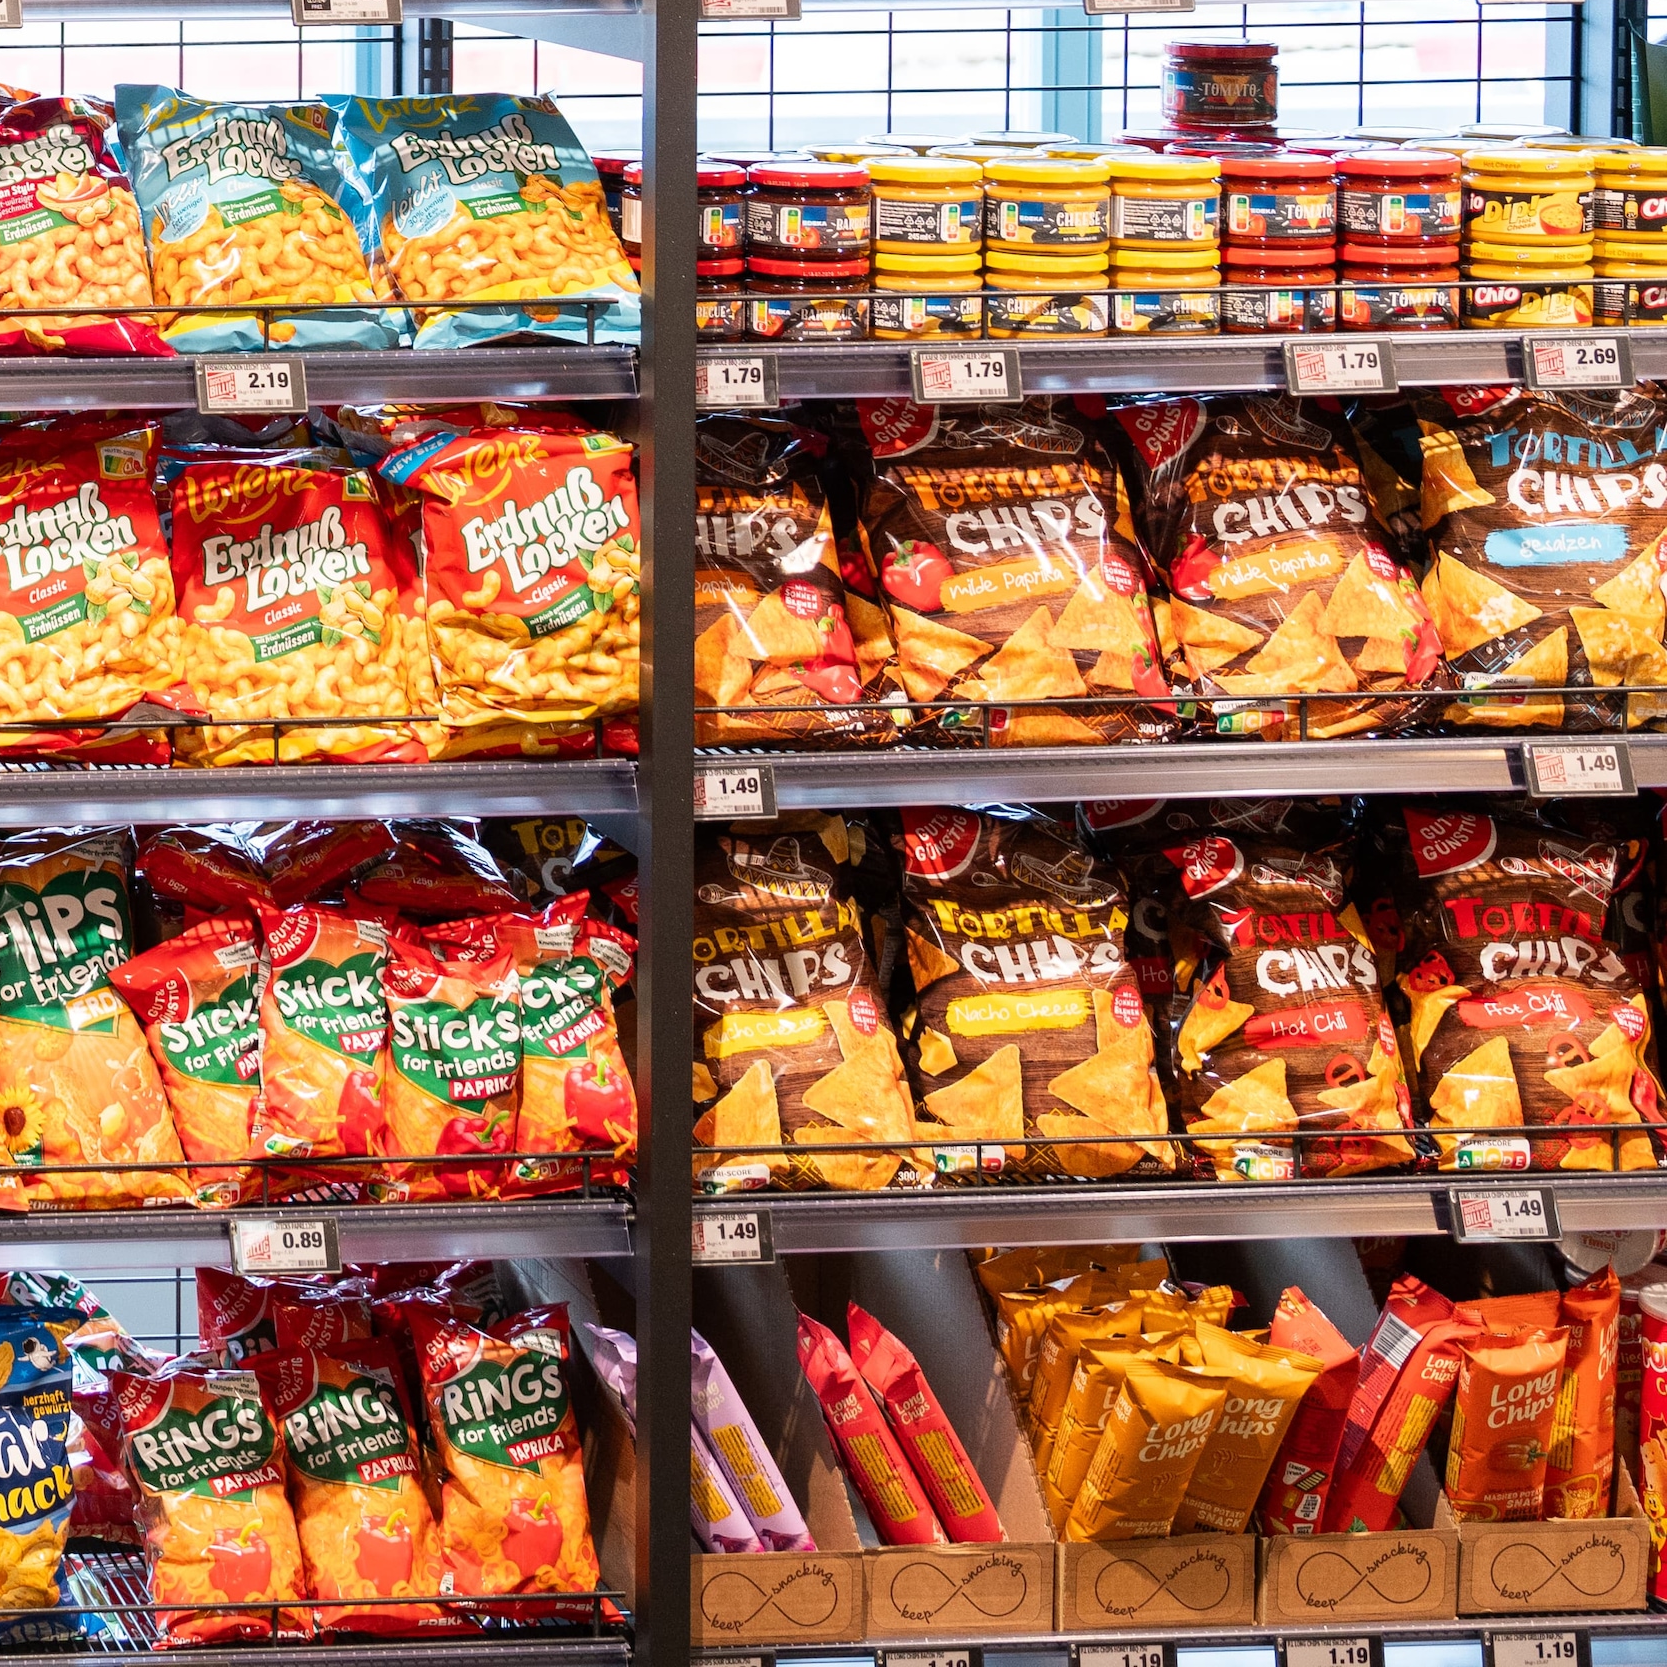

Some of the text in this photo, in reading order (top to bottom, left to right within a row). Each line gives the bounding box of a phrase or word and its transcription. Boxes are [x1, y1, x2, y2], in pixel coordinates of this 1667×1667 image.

[1202, 82, 1256, 98] TOMATO
[390, 167, 445, 222] leicht
[476, 200, 523, 217] Erdnüssen
[1056, 211, 1100, 226] CHEESE
[1482, 197, 1538, 224] Dip!
[1576, 348, 1616, 365] 2.69
[249, 372, 289, 389] 2.19
[965, 362, 1003, 378] 1.79
[1520, 534, 1602, 557] gesalzen
[949, 564, 1073, 599] milde Paprika
[1576, 754, 1616, 773] 1.49
[957, 996, 1083, 1022] Nacho Cheese
[1270, 1013, 1348, 1038] Hot Chili
[1502, 1198, 1543, 1218] 1.49
[282, 1230, 322, 1250] 0.89
[1491, 1367, 1557, 1408] Long
[1487, 1394, 1554, 1431] Chips
[457, 1406, 557, 1446] for Friends
[509, 1435, 565, 1462] PAPRIKA
[1499, 1536, 1622, 1604] keep snacking
[1536, 1641, 1575, 1658] 1.19
